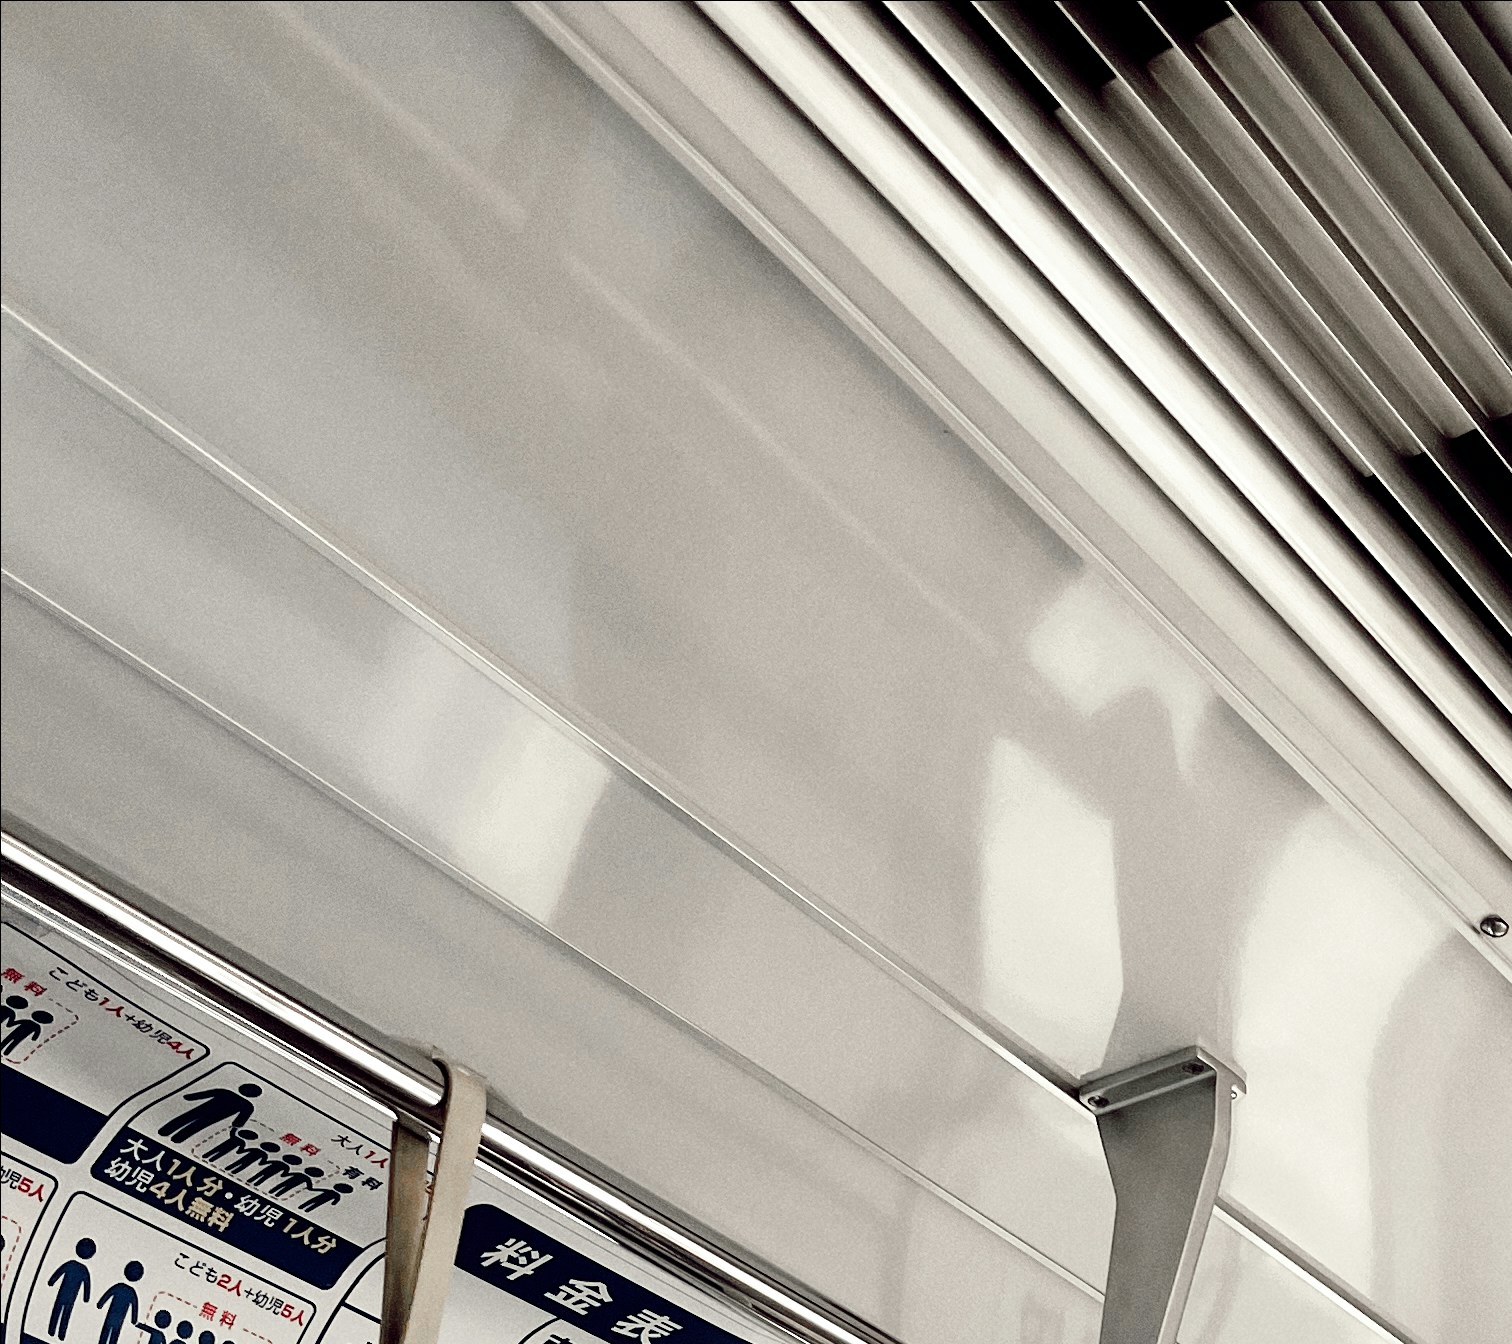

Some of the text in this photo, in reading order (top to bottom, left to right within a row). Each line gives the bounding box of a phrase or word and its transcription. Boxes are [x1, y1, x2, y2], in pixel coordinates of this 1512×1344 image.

[49, 966, 195, 1060] こども1人+幼児4人
[103, 1157, 235, 1233] 幼児4人無料
[174, 1252, 306, 1327] こども2人+幼児5人
[199, 1302, 237, 1330] 無料
